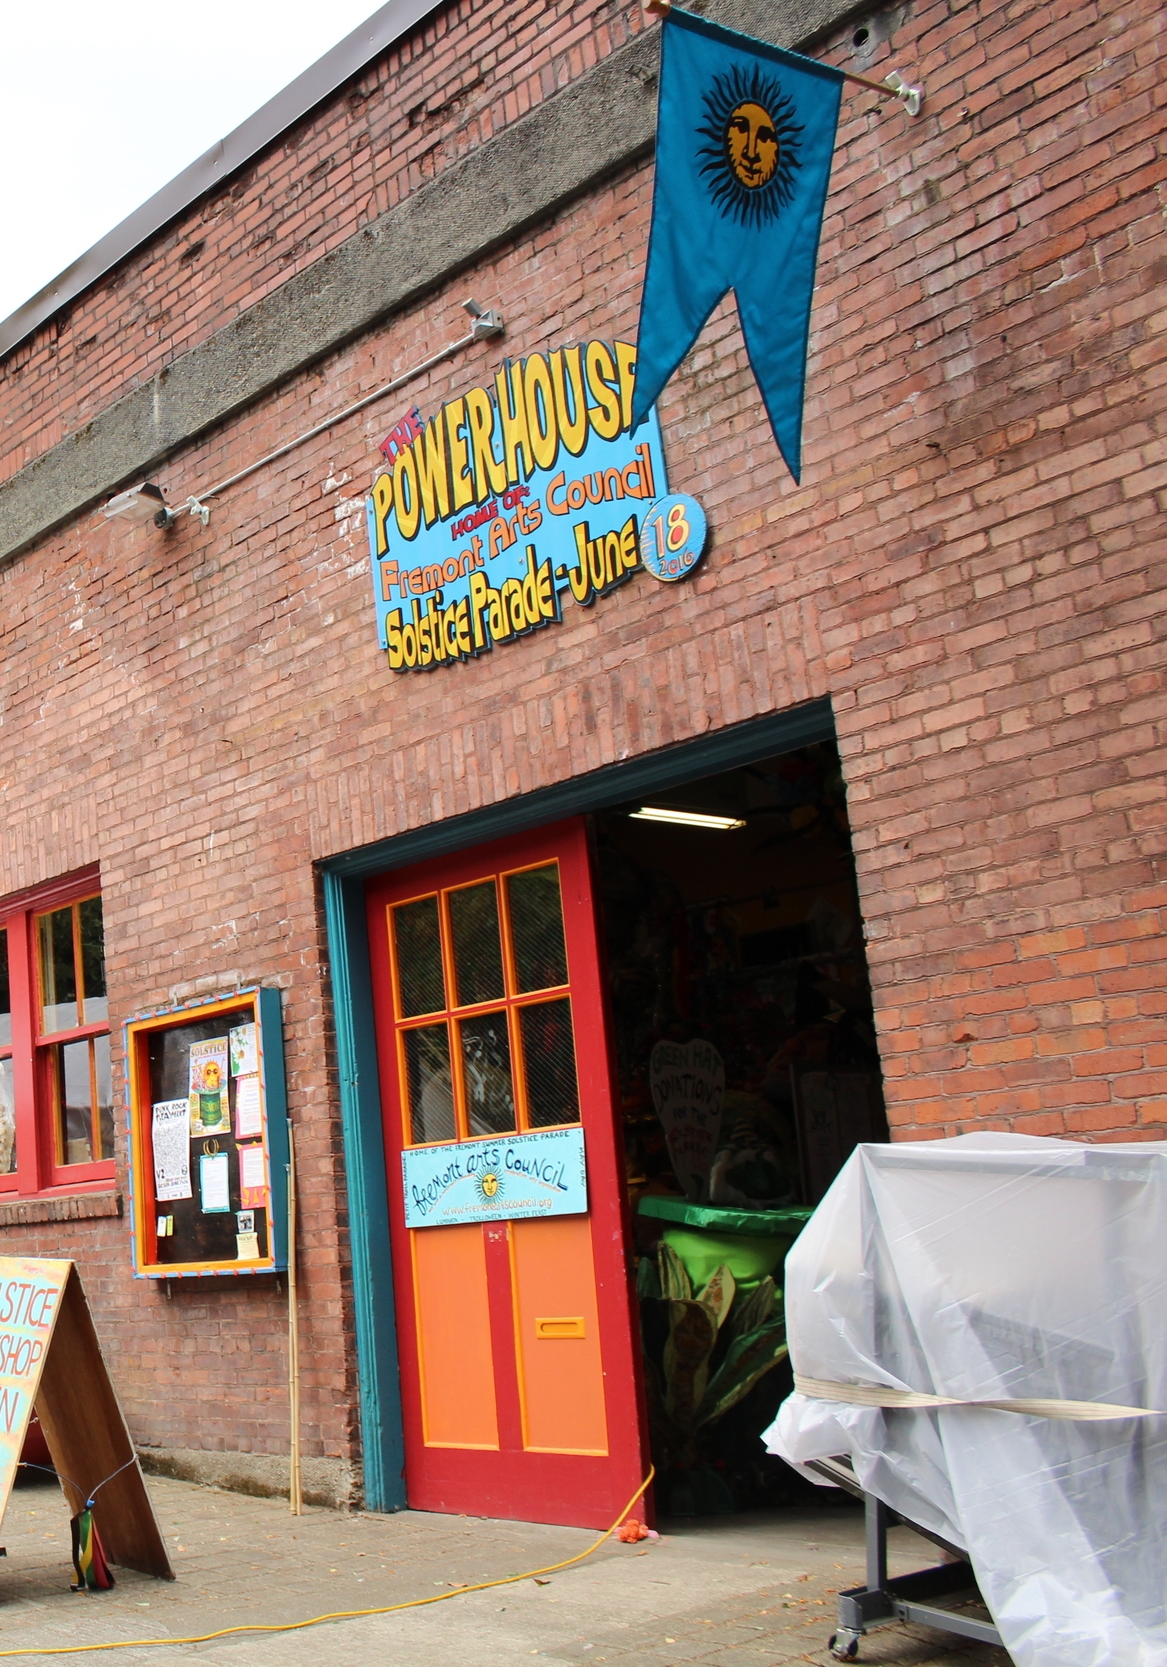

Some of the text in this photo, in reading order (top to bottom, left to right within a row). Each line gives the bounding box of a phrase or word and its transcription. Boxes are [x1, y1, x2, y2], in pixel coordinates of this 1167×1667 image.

[379, 405, 425, 467] THE
[379, 442, 656, 601] Fremont Arts Council
[450, 500, 498, 541] HOME
[652, 502, 690, 559] 18
[658, 549, 694, 576] 2016
[385, 588, 472, 669] Solstice
[189, 1040, 228, 1059] SOLSTICE
[653, 1044, 723, 1076] GREEN HAT
[171, 1101, 188, 1110] ROCK
[691, 1106, 708, 1127] THE
[409, 1149, 428, 1157] HOME
[440, 1145, 454, 1153] THE
[455, 1142, 481, 1151] FREMONT
[482, 1139, 507, 1147] SUMMER
[507, 1135, 539, 1145] SOLSTICE
[540, 1130, 570, 1140] PARADE
[156, 1169, 165, 1179] V2
[503, 1210, 530, 1219] WINTER
